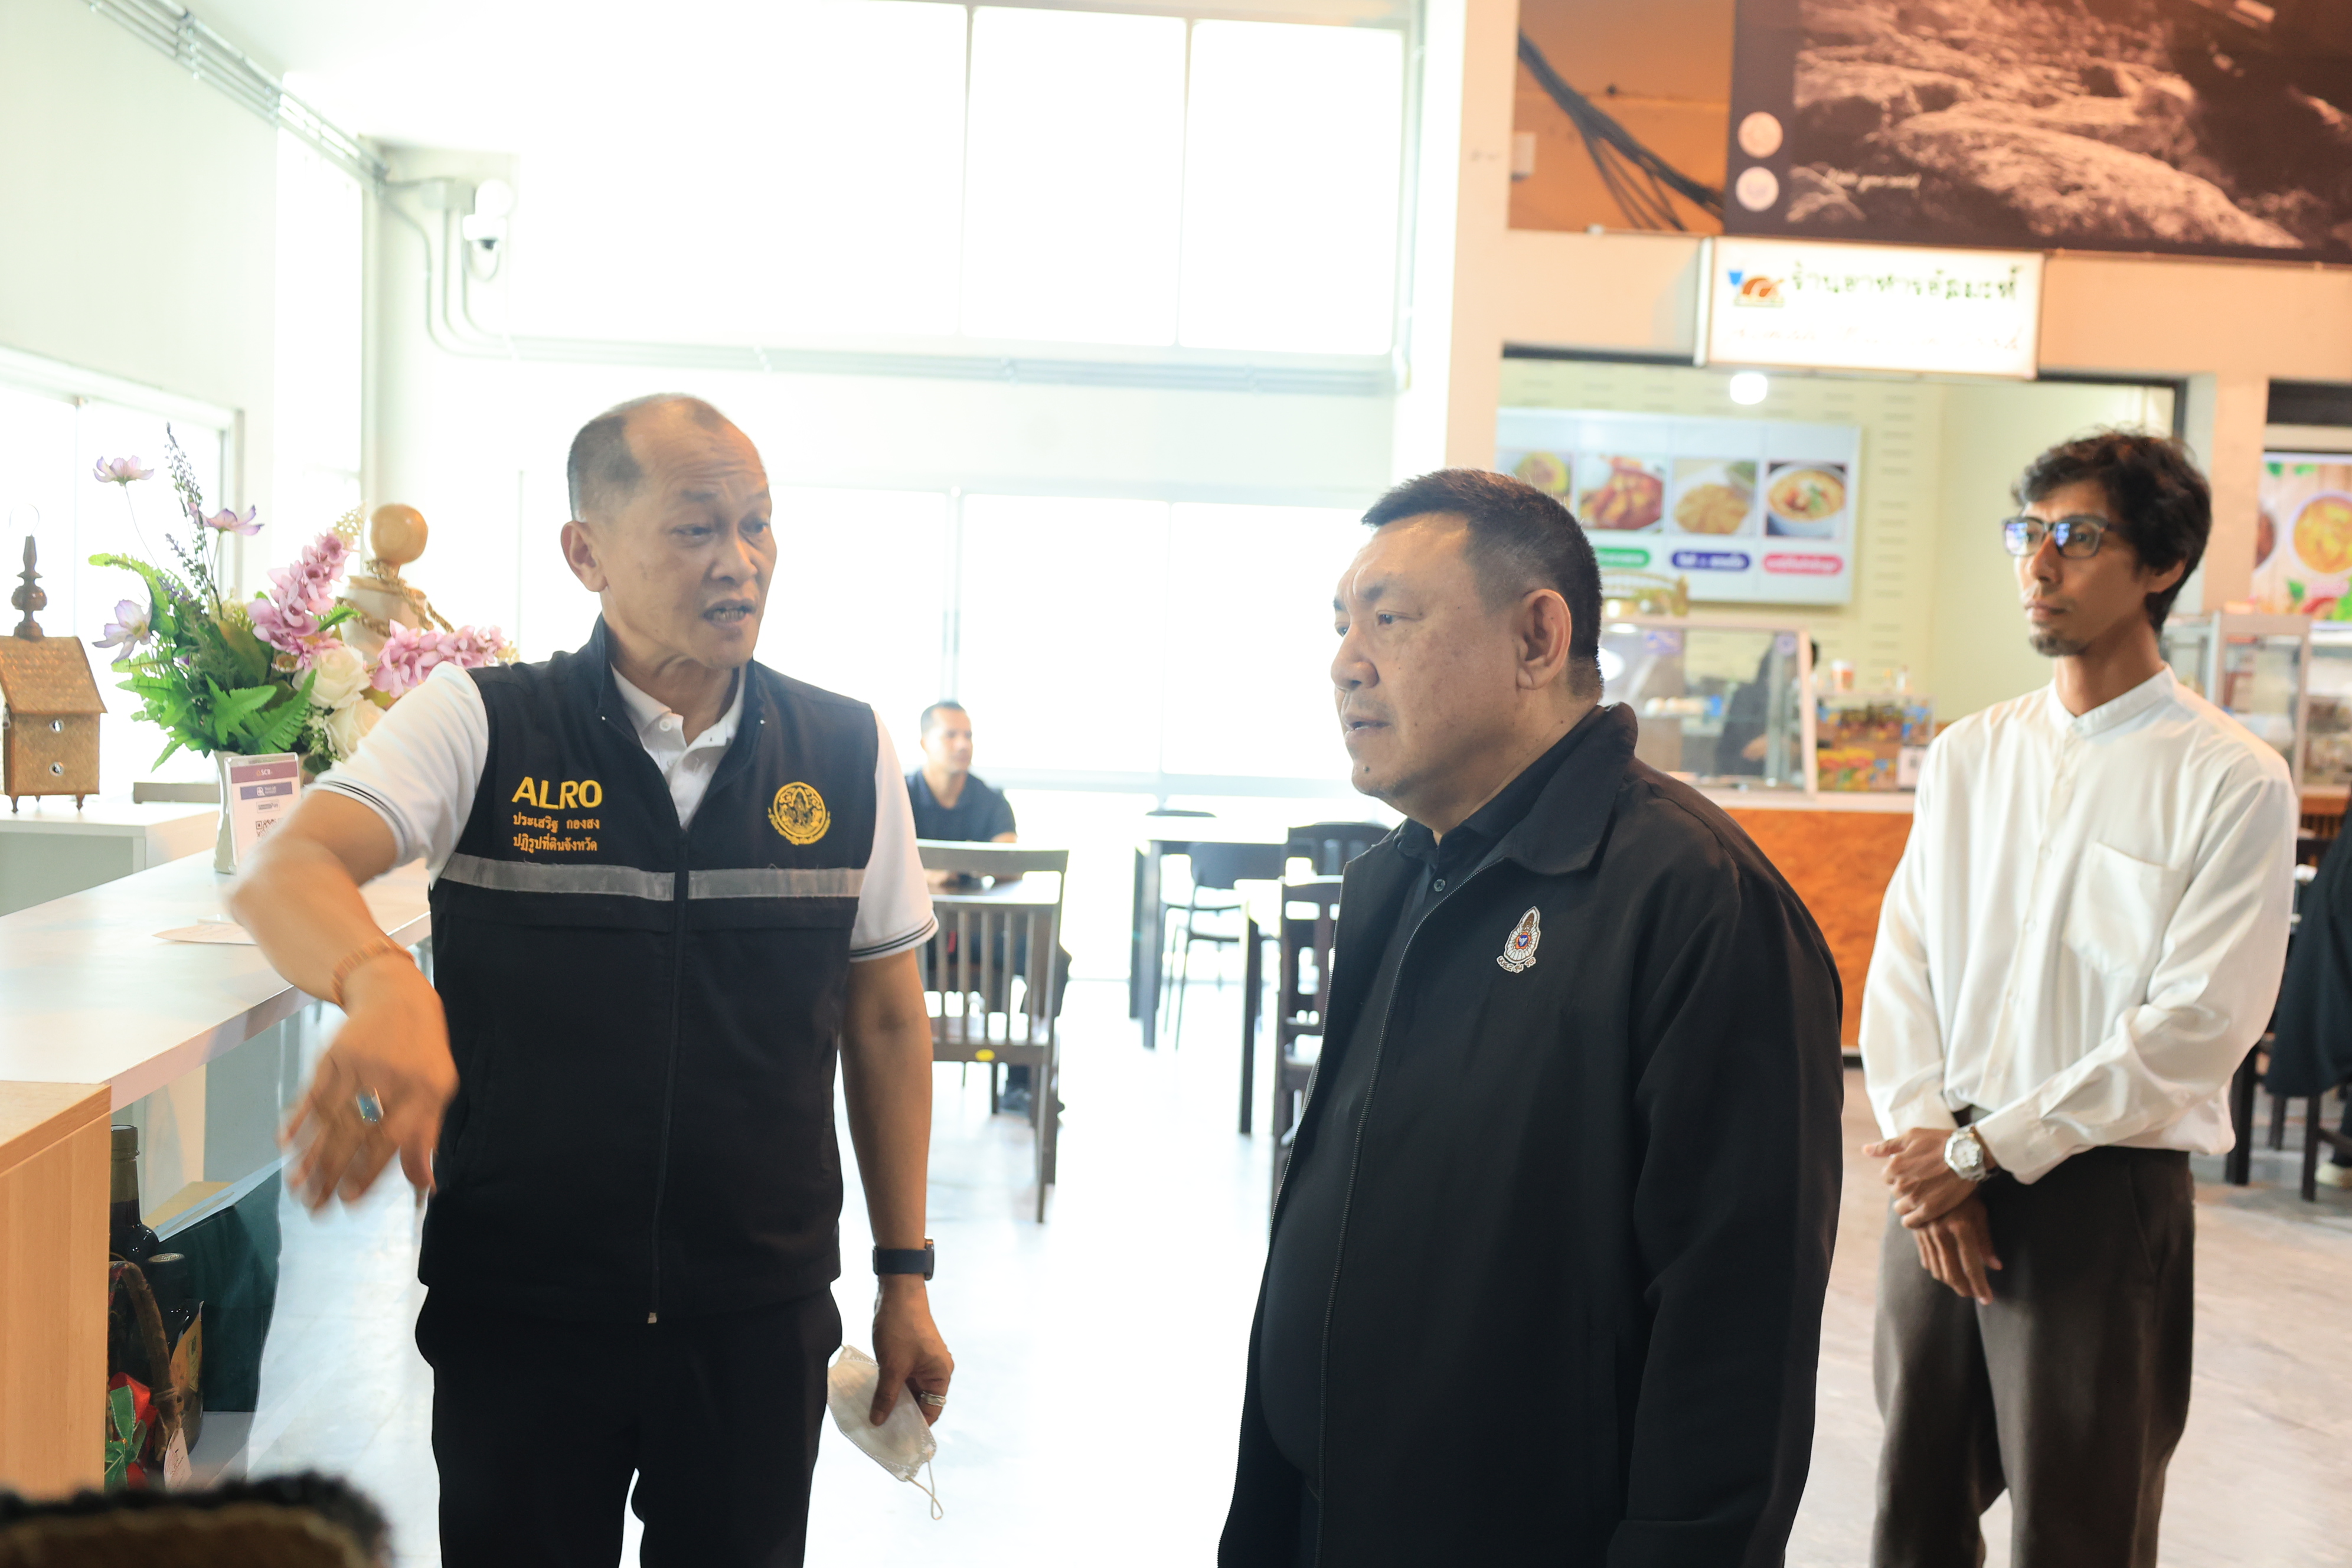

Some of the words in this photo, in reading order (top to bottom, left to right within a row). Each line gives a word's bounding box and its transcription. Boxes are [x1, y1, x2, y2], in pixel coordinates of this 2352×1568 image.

[511, 776, 603, 810] ALRO
[512, 812, 559, 833] ประเสริฐ
[512, 833, 598, 854] ปฏิรูปที่ดินจังหวัด
